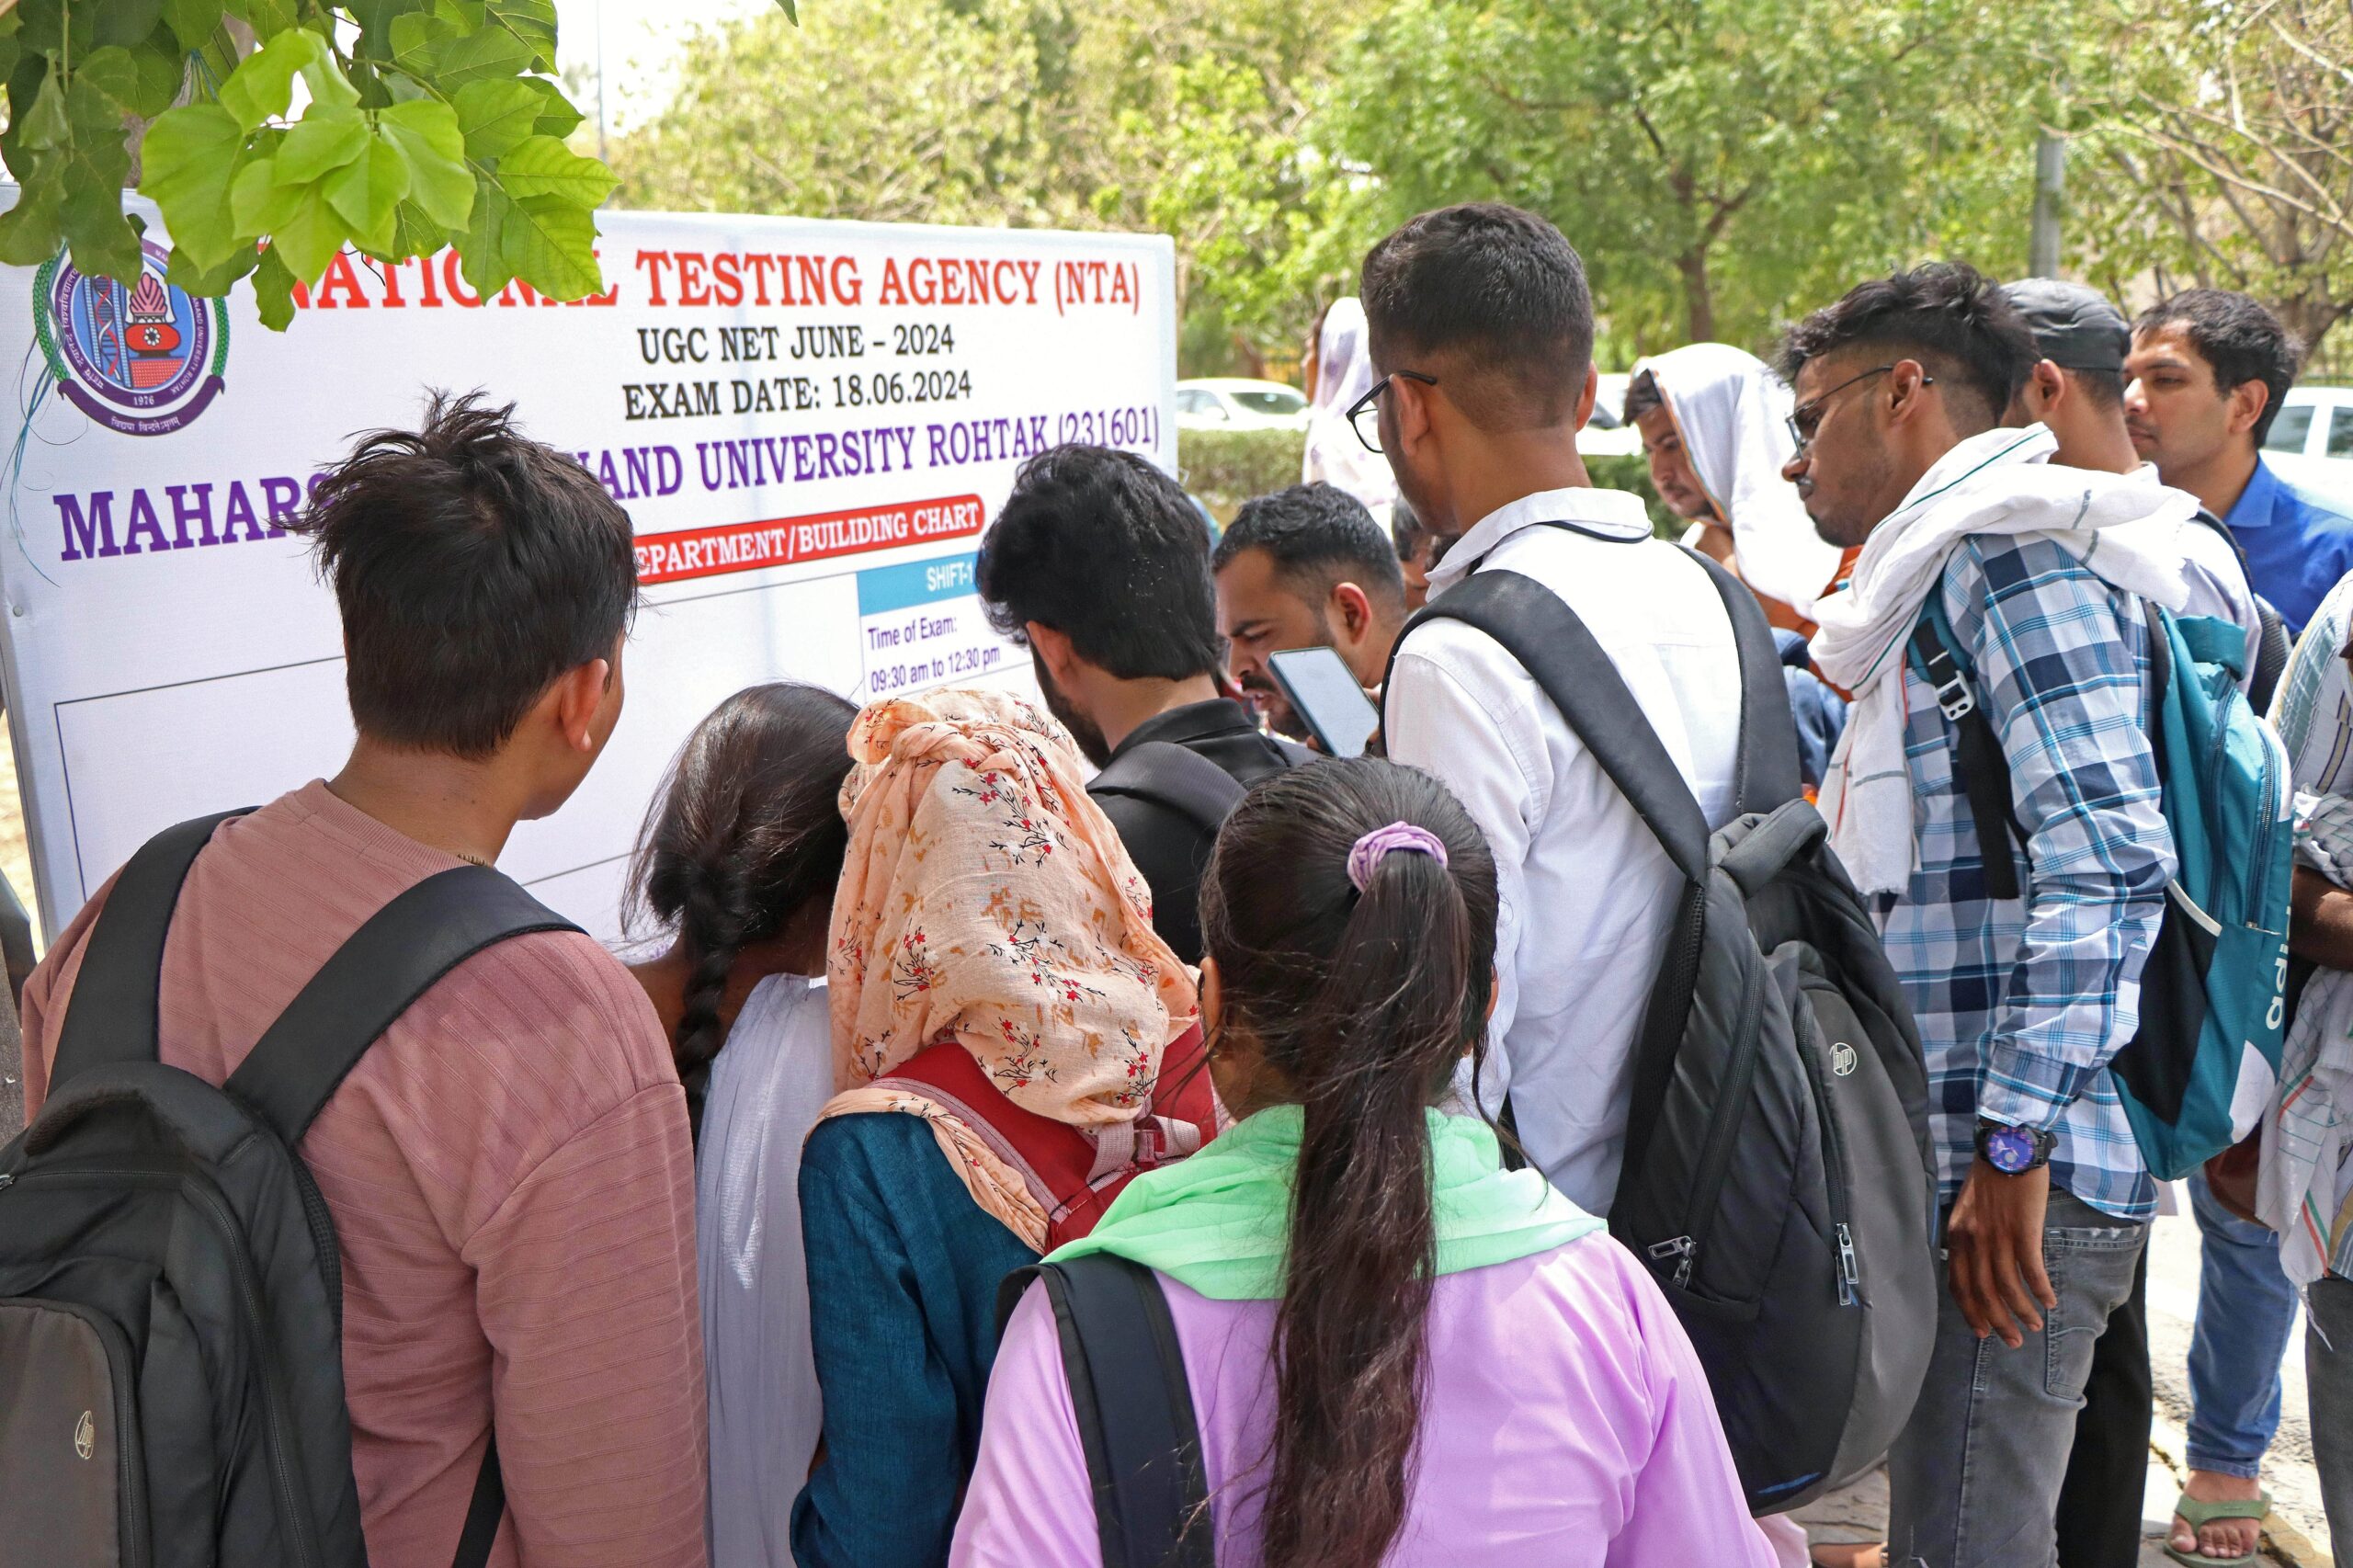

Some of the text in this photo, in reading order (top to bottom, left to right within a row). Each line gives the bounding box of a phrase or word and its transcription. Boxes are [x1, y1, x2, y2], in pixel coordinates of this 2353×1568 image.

[256, 243, 1140, 318] ATIO TESTING AGENCY (NTA)
[637, 326, 709, 365] UGC
[719, 325, 779, 361] NET
[790, 324, 865, 359] JUNE
[893, 323, 955, 356] 2024
[132, 395, 155, 406] 1976
[623, 369, 972, 421] EXAM DATE: 18.06.2024
[577, 444, 683, 501] AND
[695, 426, 916, 492] UNIVERSITY
[926, 415, 1048, 468] ROHTAK
[1058, 405, 1159, 454] (231601)
[634, 501, 980, 578] EPARTMENT/BUILIDING CHART
[926, 562, 973, 592] SHIFT-1
[868, 617, 958, 651] Time of Exam:
[870, 646, 1001, 693] 09:30 am to 12:30 pm
[1829, 1041, 1858, 1076] hp
